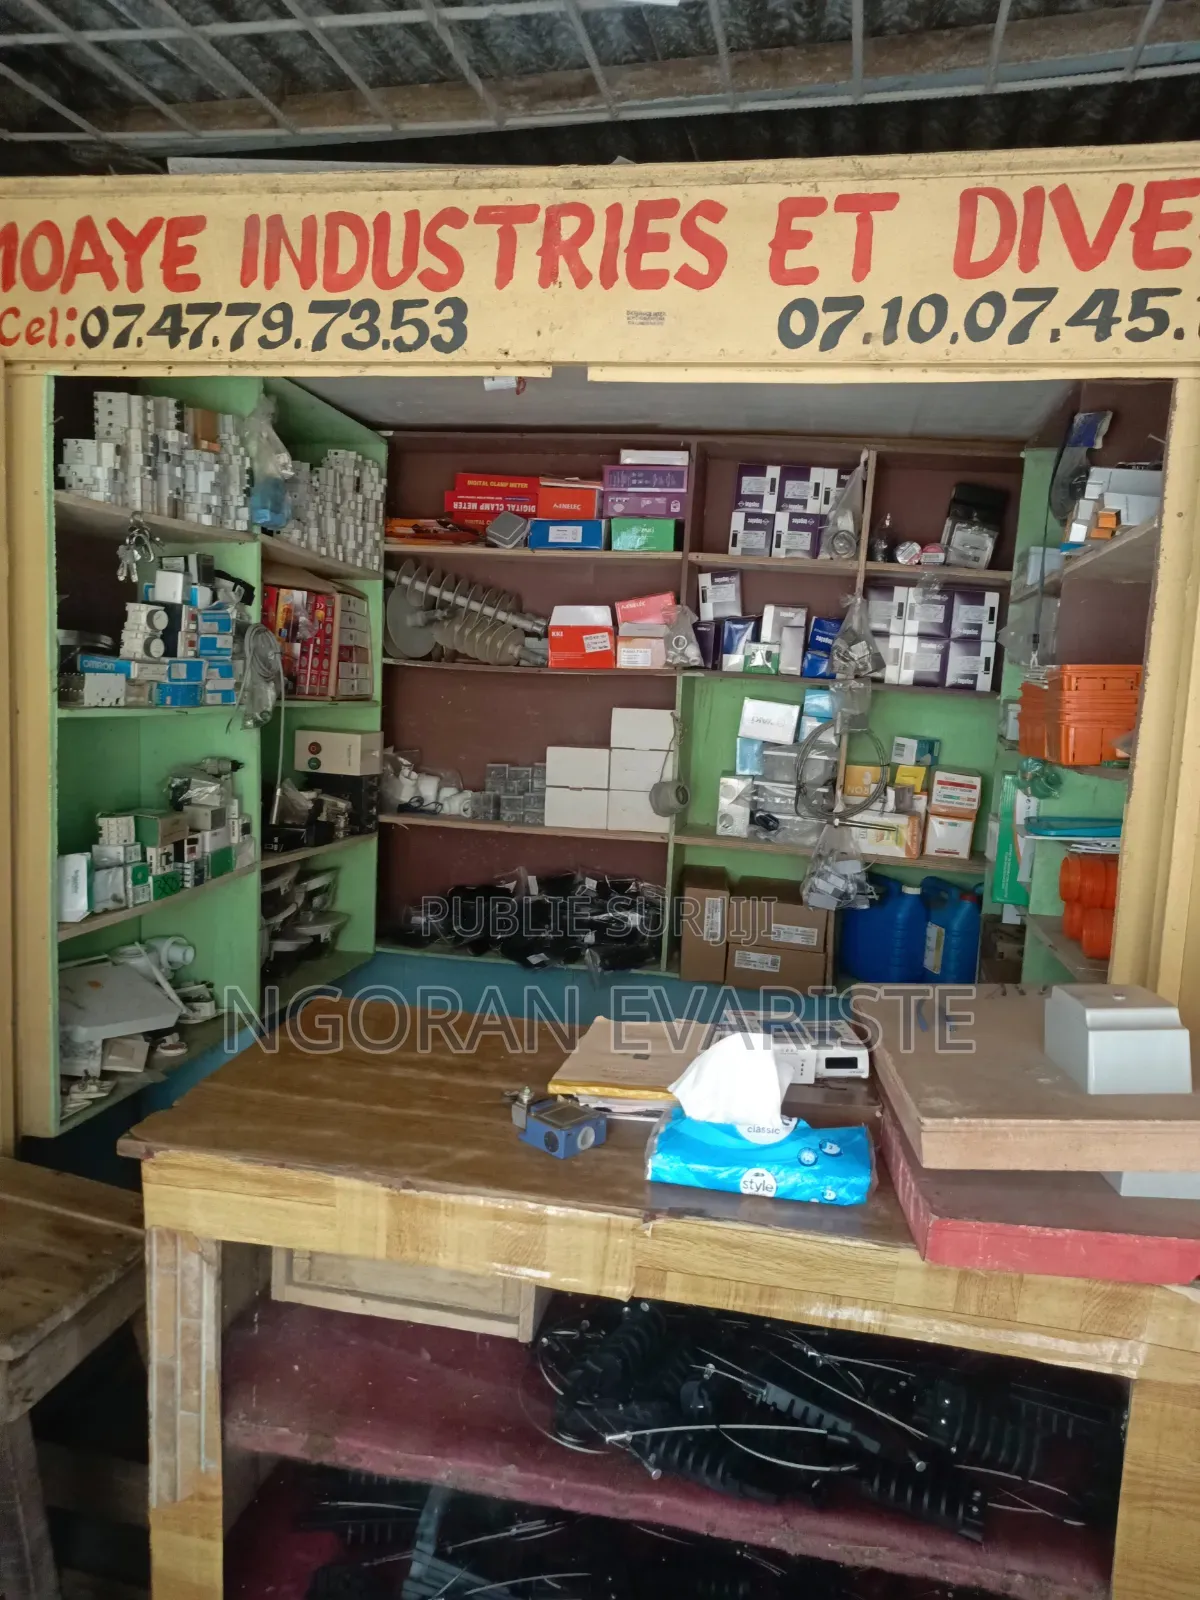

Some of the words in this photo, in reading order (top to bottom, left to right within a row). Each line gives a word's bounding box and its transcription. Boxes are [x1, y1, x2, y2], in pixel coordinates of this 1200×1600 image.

[241, 198, 728, 293] INDUSTRIES
[769, 192, 900, 286] ET
[952, 178, 1200, 280] DIVE
[80, 296, 468, 354] 07.47.79.73.53
[777, 287, 1200, 353] 07.10.07.45.
[453, 501, 478, 510] METER
[480, 502, 504, 511] CLAMP
[507, 503, 536, 513] DIGITAL
[747, 1124, 781, 1135] classic
[743, 1179, 774, 1192] style
